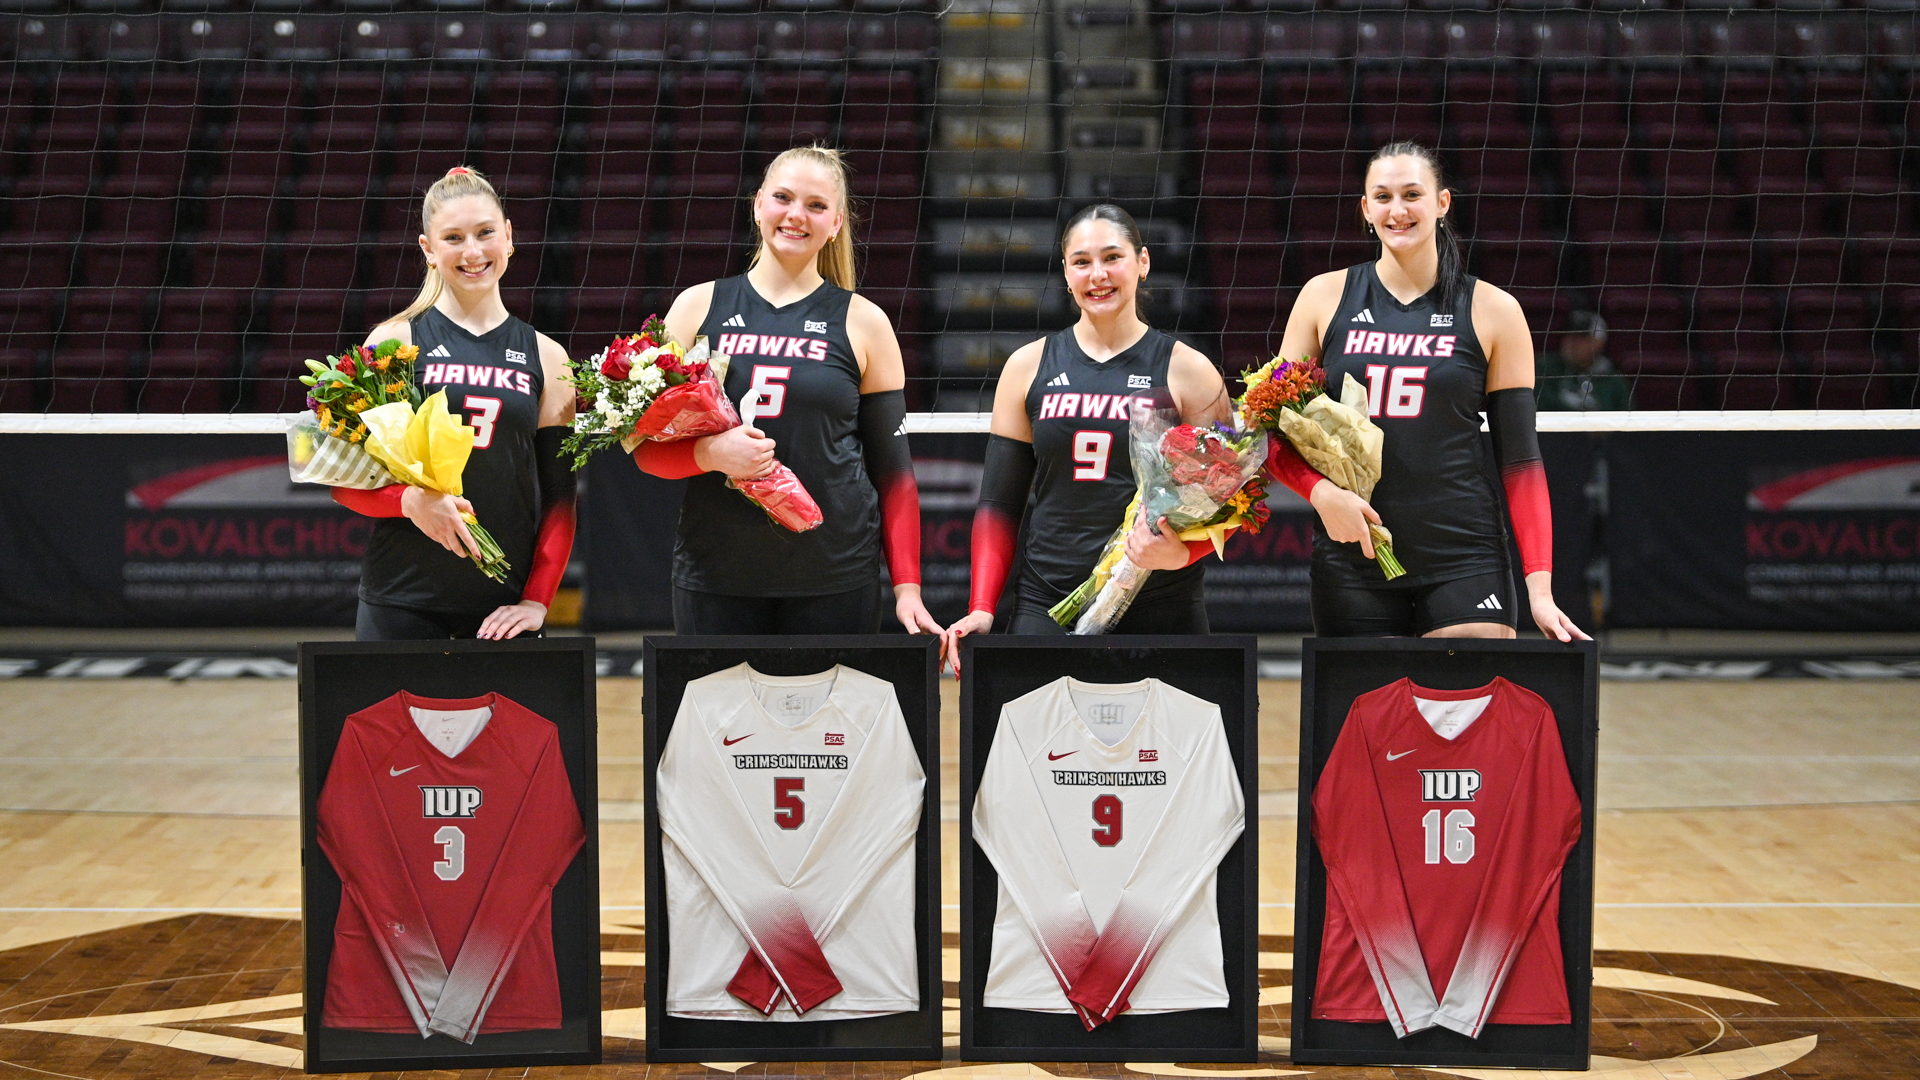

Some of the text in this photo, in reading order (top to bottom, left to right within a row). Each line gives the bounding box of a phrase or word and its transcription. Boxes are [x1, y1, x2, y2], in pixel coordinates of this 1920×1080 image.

[1430, 316, 1453, 325] PSAC
[505, 351, 527, 363] PSAC
[717, 333, 829, 362] HAWKS
[1343, 329, 1457, 358] HAWKS
[422, 363, 532, 396] HAWKS
[750, 364, 792, 419] 5
[1127, 377, 1152, 387] PSAC
[1364, 363, 1429, 419] 16
[462, 394, 503, 450] 3
[1072, 429, 1114, 482] 9
[124, 517, 375, 558] KOVALCHIC
[1745, 519, 1920, 559] KOVALC
[824, 735, 845, 744] PSAC
[1138, 751, 1159, 760] PSAC
[731, 754, 848, 770] CRIMSON HAWKS
[1050, 770, 1167, 786] CRIMSON HAWKS
[417, 785, 483, 819] IUP
[1417, 769, 1482, 802] IUP
[774, 777, 805, 831] 5
[1092, 794, 1123, 848] 9
[1421, 809, 1476, 865] 16
[433, 825, 466, 881] 3
